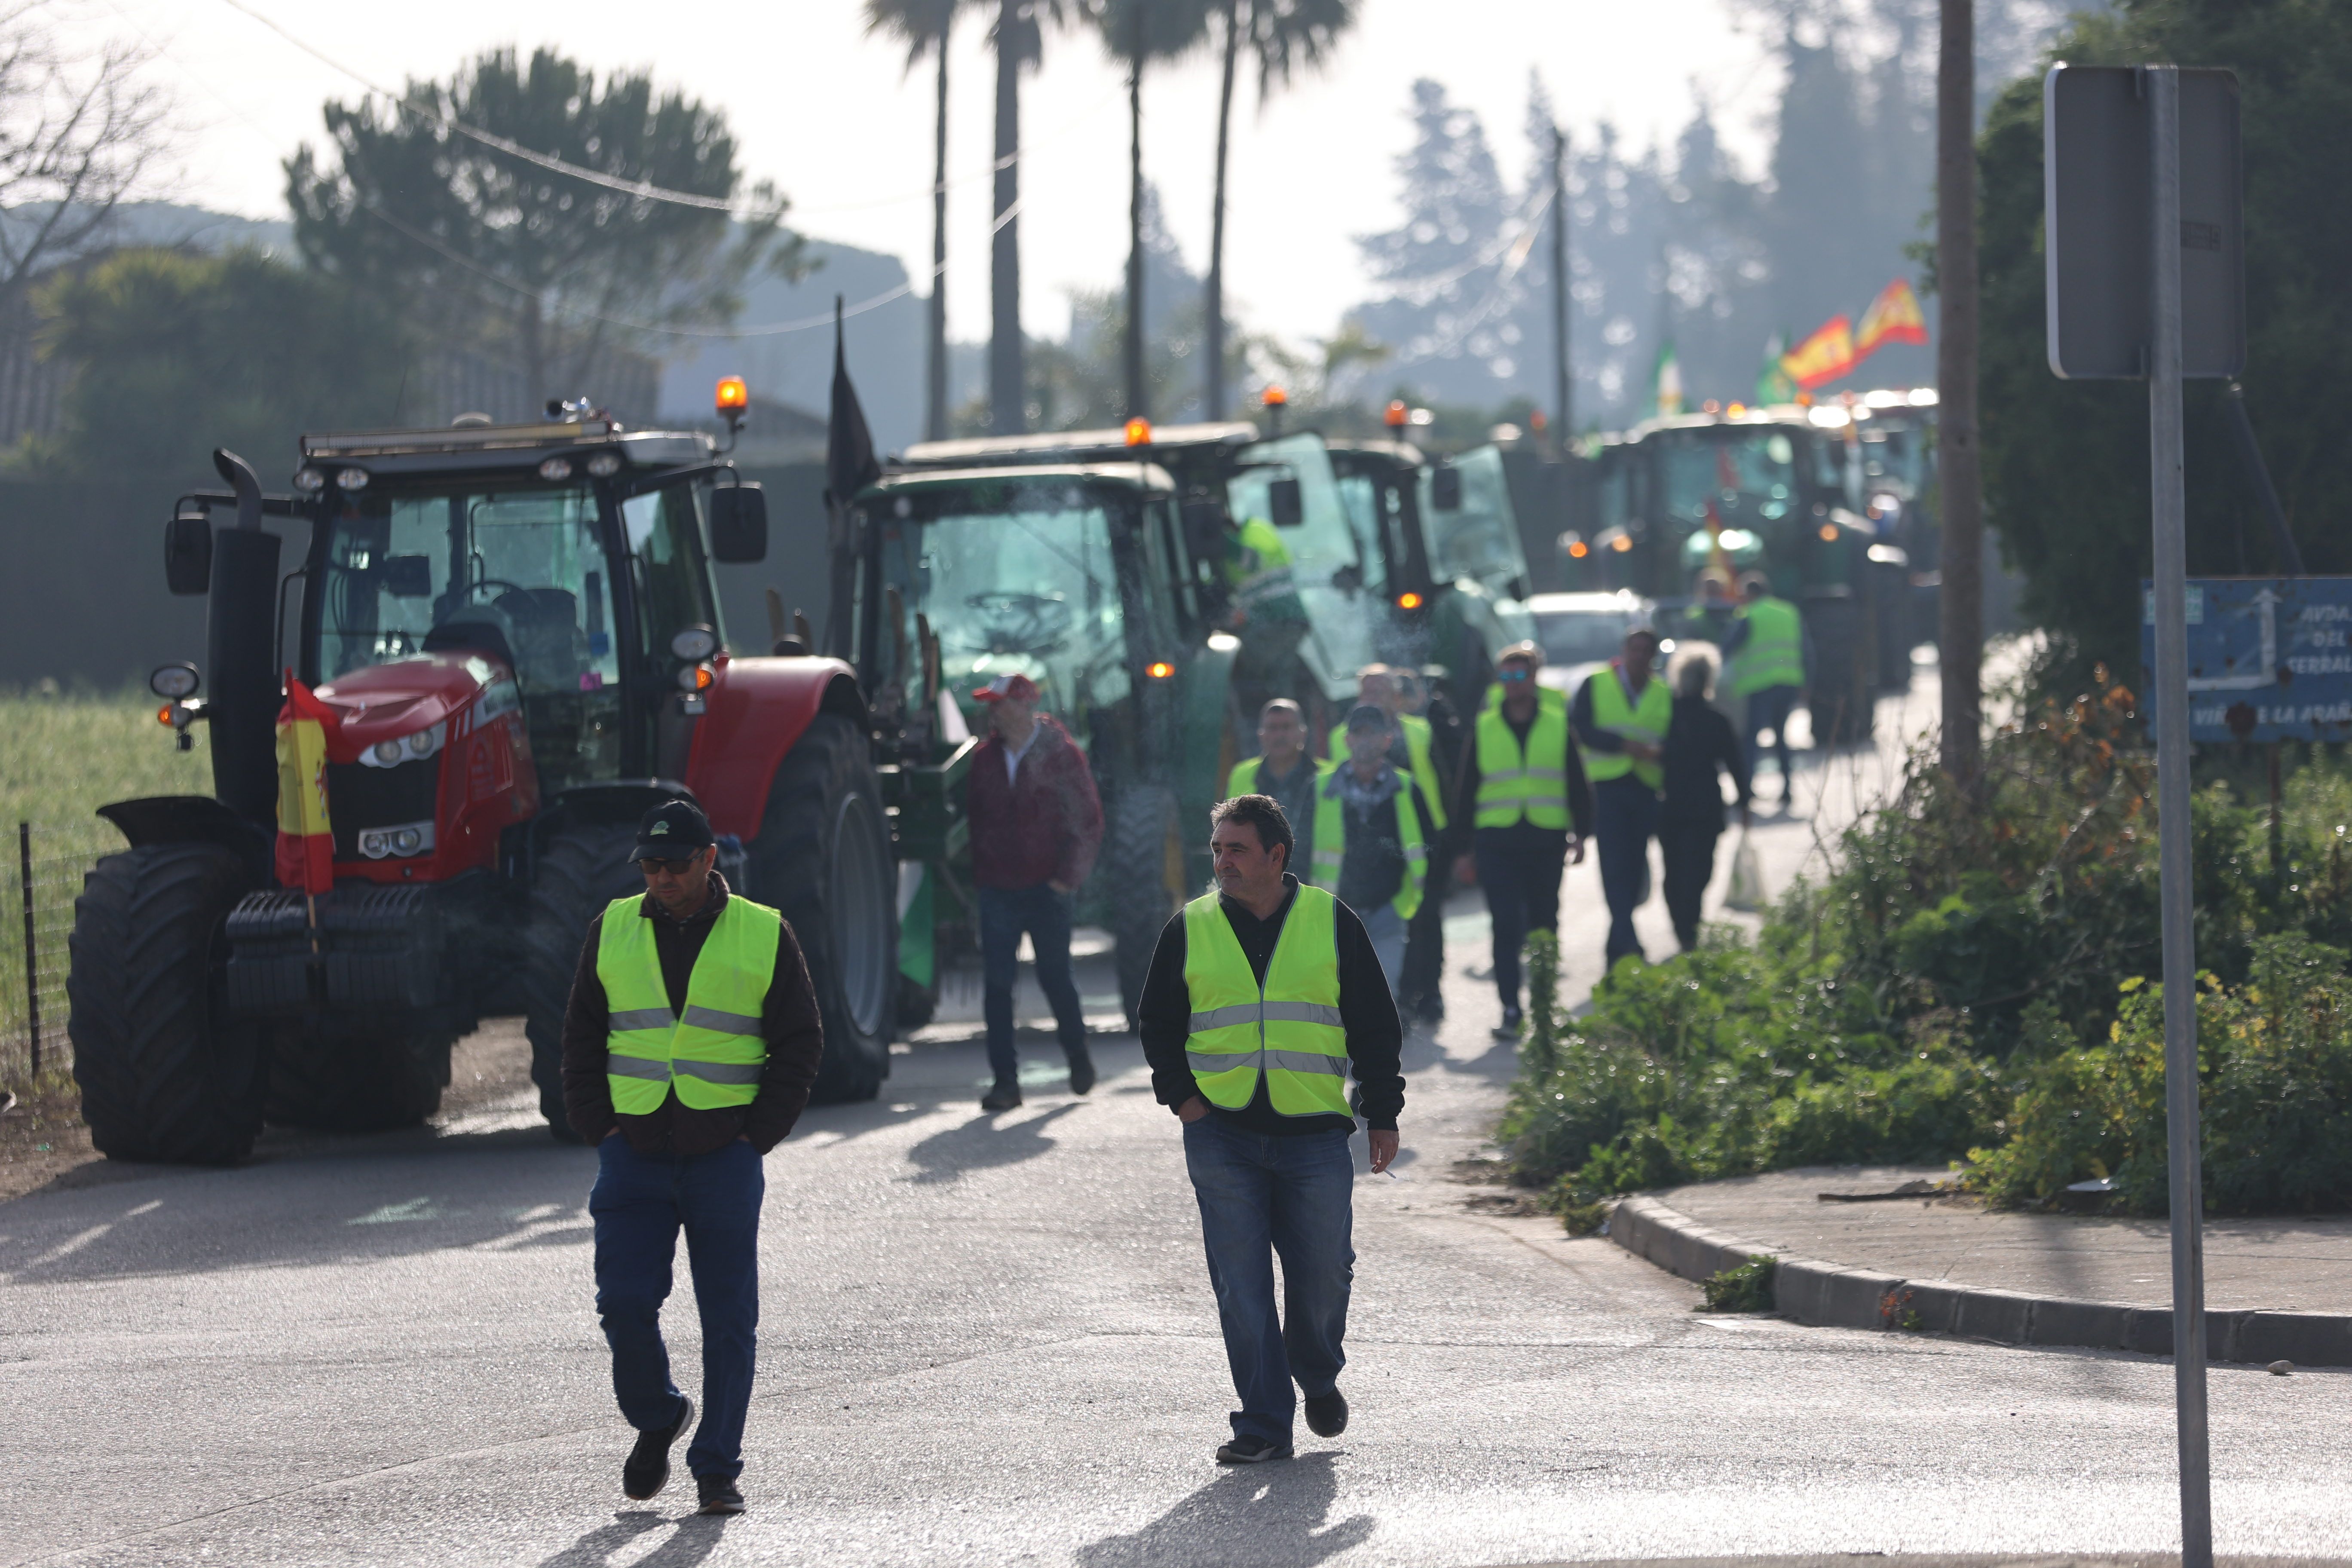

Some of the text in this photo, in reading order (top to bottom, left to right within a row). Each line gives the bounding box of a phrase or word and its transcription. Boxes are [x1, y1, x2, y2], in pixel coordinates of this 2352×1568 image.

[2313, 631, 2346, 646] DEL
[2273, 705, 2295, 723] LA
[2300, 701, 2352, 722] ARAÑ
